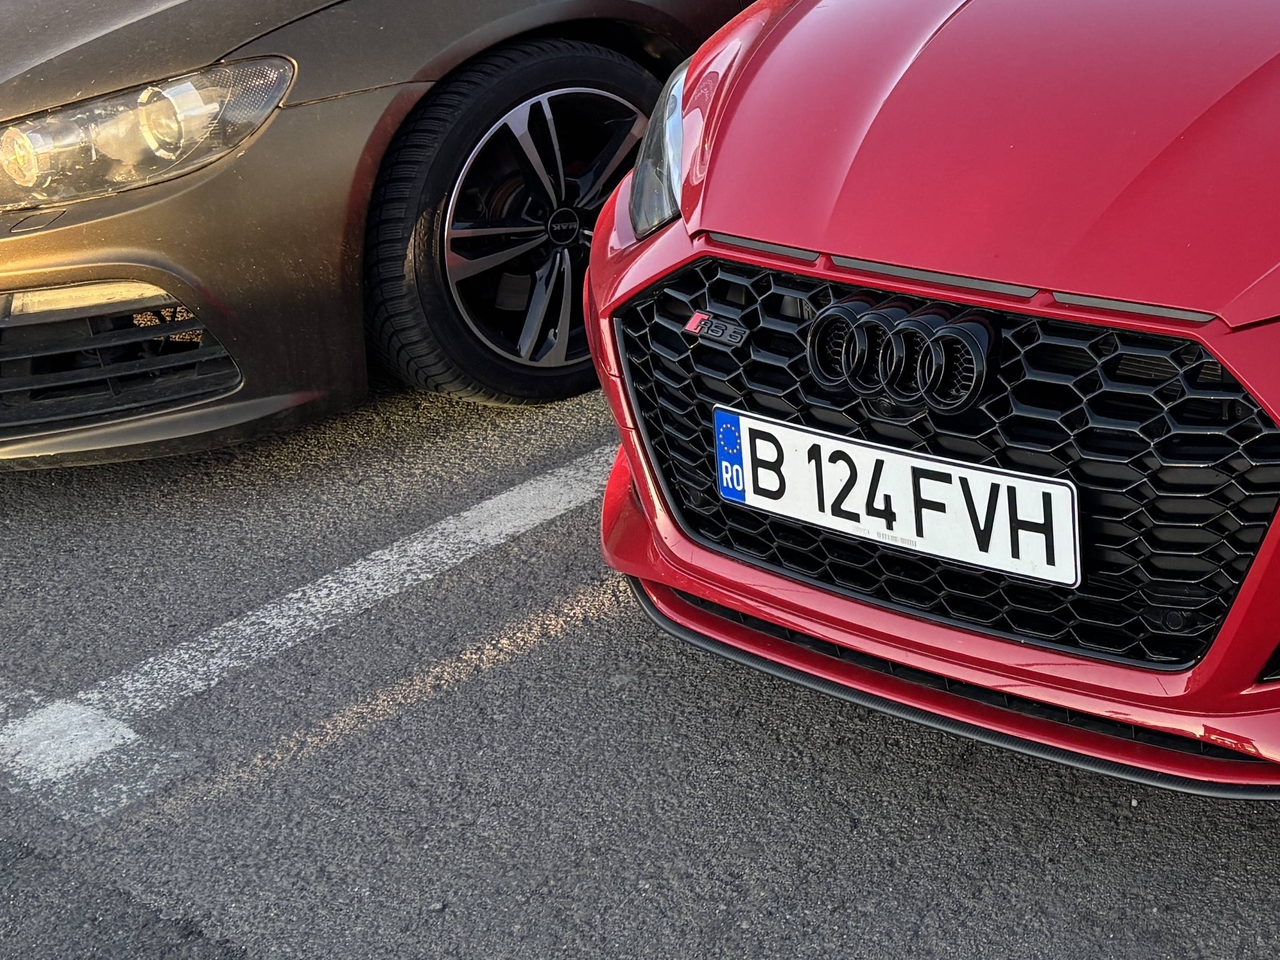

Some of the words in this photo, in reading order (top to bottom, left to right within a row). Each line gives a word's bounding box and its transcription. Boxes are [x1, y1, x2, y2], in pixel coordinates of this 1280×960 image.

[721, 460, 743, 491] RO
[748, 427, 786, 500] B
[807, 443, 897, 530] 124
[911, 466, 1056, 567] FVH
